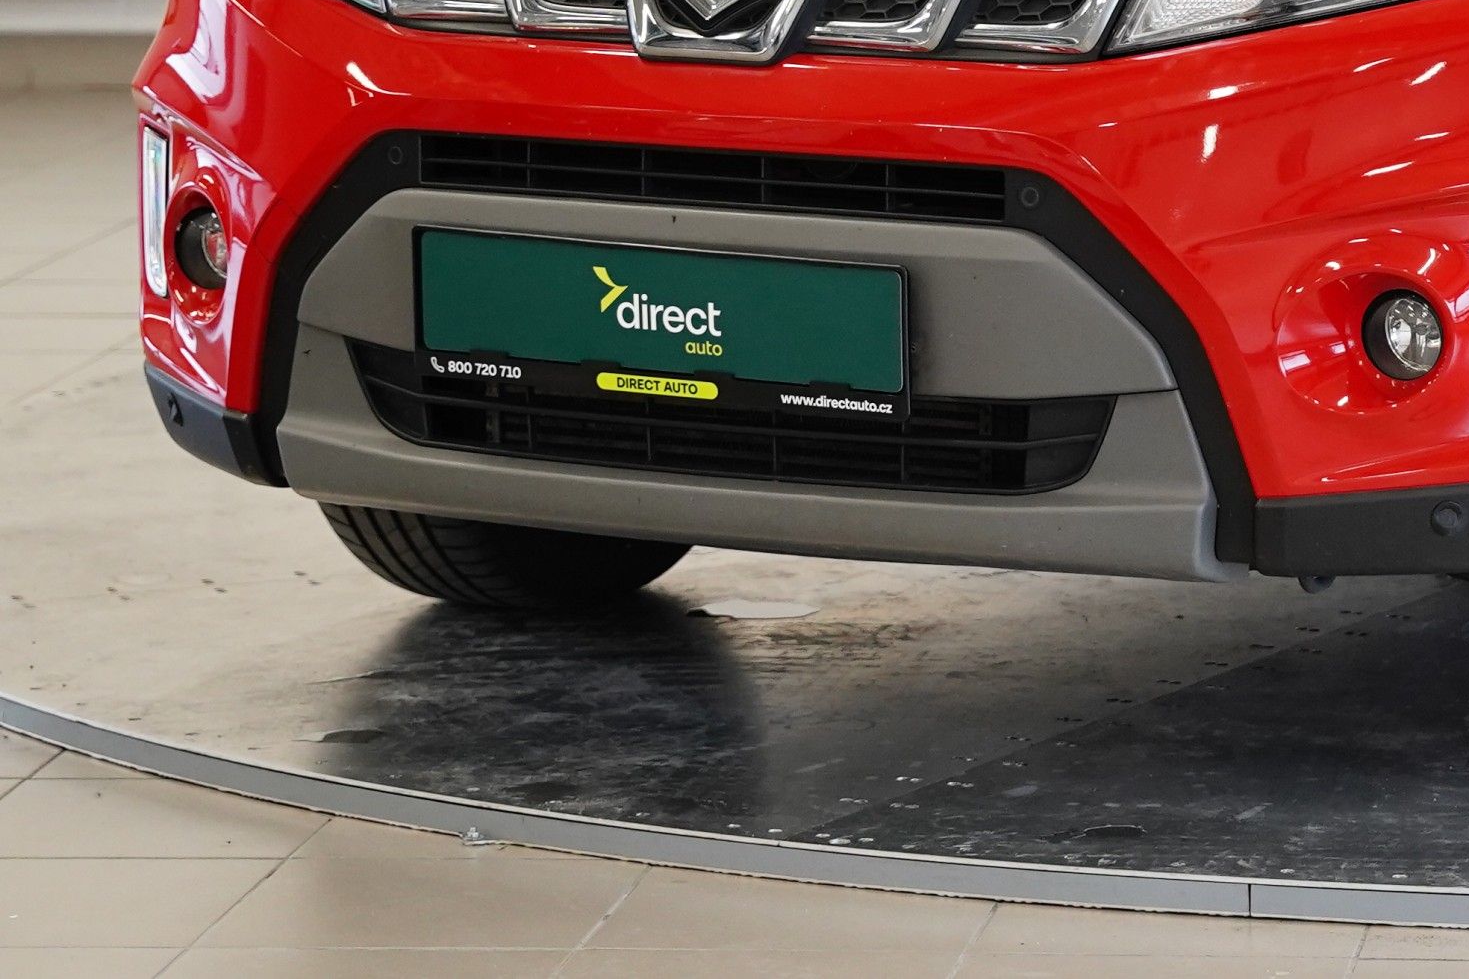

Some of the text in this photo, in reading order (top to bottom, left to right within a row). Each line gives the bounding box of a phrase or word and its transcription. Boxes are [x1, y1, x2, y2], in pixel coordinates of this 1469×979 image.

[616, 293, 722, 337] direct
[685, 340, 722, 356] auto
[447, 360, 522, 379] 800 720 710
[616, 377, 698, 394] DIRECT AUTO
[780, 394, 893, 414] www.directauto.cz
